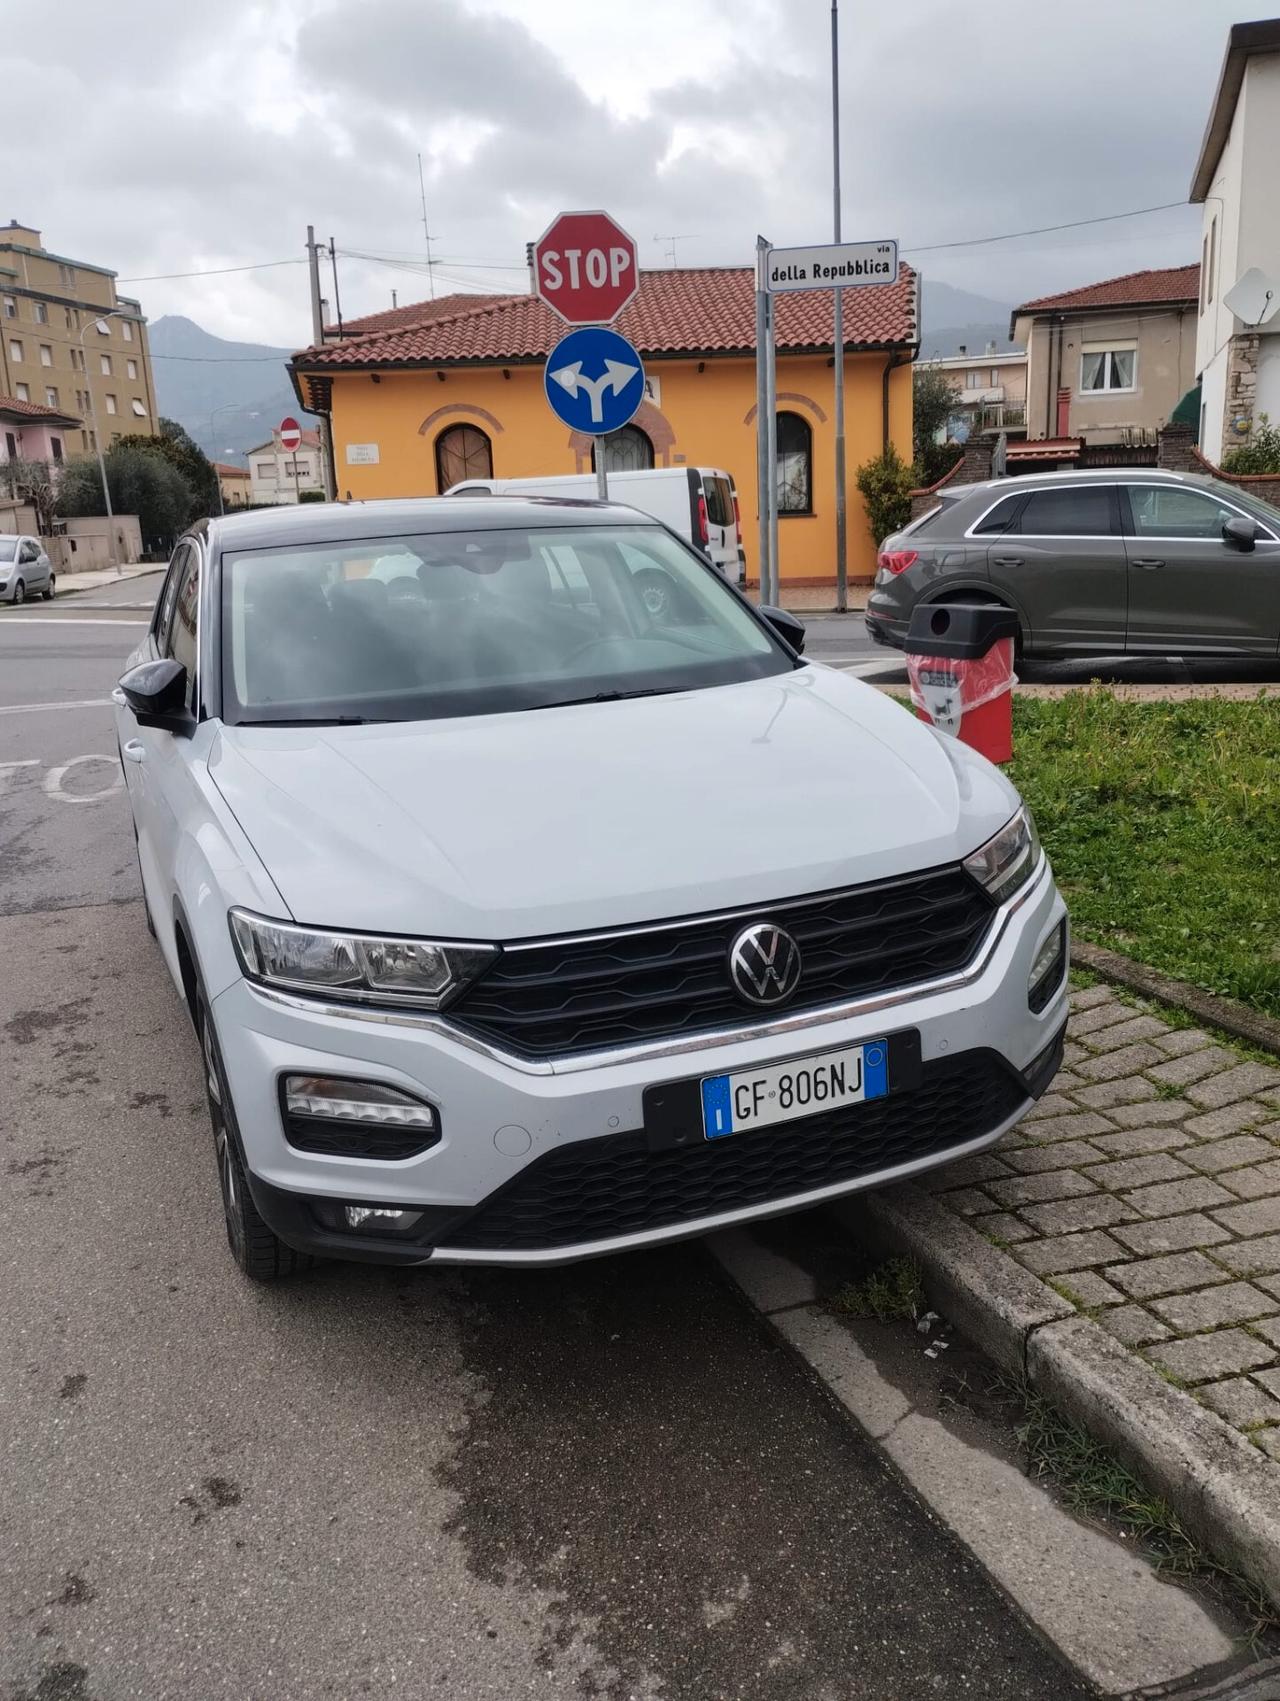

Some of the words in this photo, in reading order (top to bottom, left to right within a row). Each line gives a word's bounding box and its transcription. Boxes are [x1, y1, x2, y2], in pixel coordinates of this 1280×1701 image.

[877, 245, 890, 253] via
[541, 247, 630, 290] STOP
[772, 265, 806, 281] della
[813, 259, 890, 280] Repubblica
